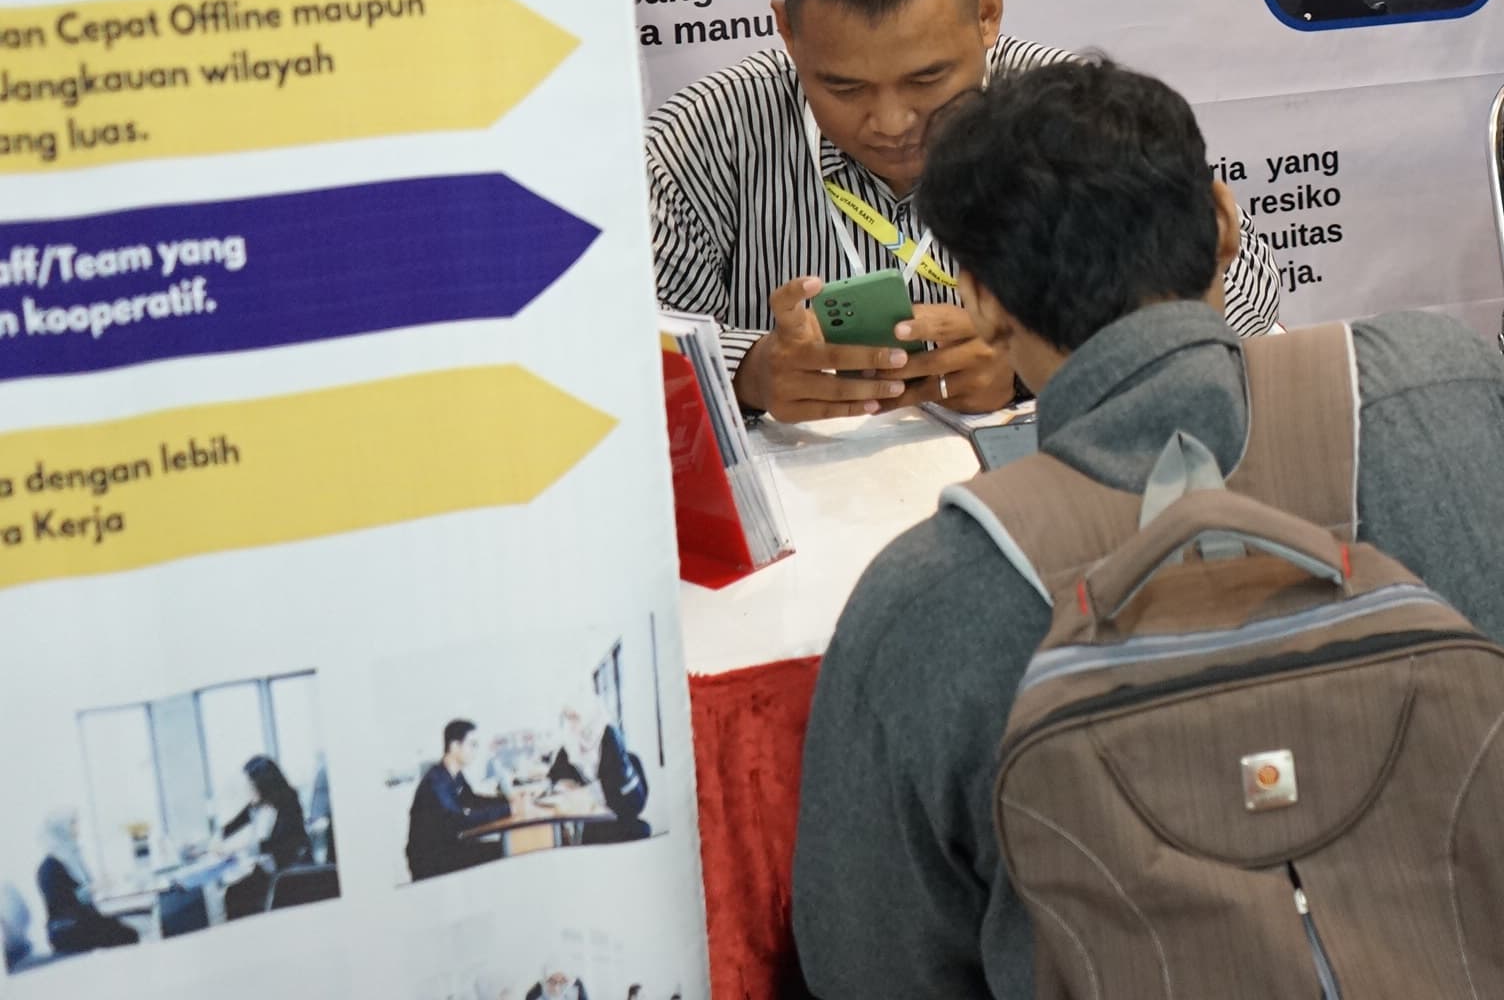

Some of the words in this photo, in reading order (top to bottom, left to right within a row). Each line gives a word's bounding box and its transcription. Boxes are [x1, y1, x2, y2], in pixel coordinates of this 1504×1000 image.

[56, 10, 159, 52] Cepat
[170, 0, 282, 35] Offline
[200, 45, 335, 90] wilayah
[68, 118, 148, 151] luas.
[1267, 150, 1338, 183] yang
[1250, 184, 1341, 215] resiko
[159, 235, 247, 277] yang
[23, 277, 217, 340] kooperatif.
[25, 459, 152, 497] dengan
[161, 435, 240, 476] lebih
[32, 507, 125, 544] Kerja
